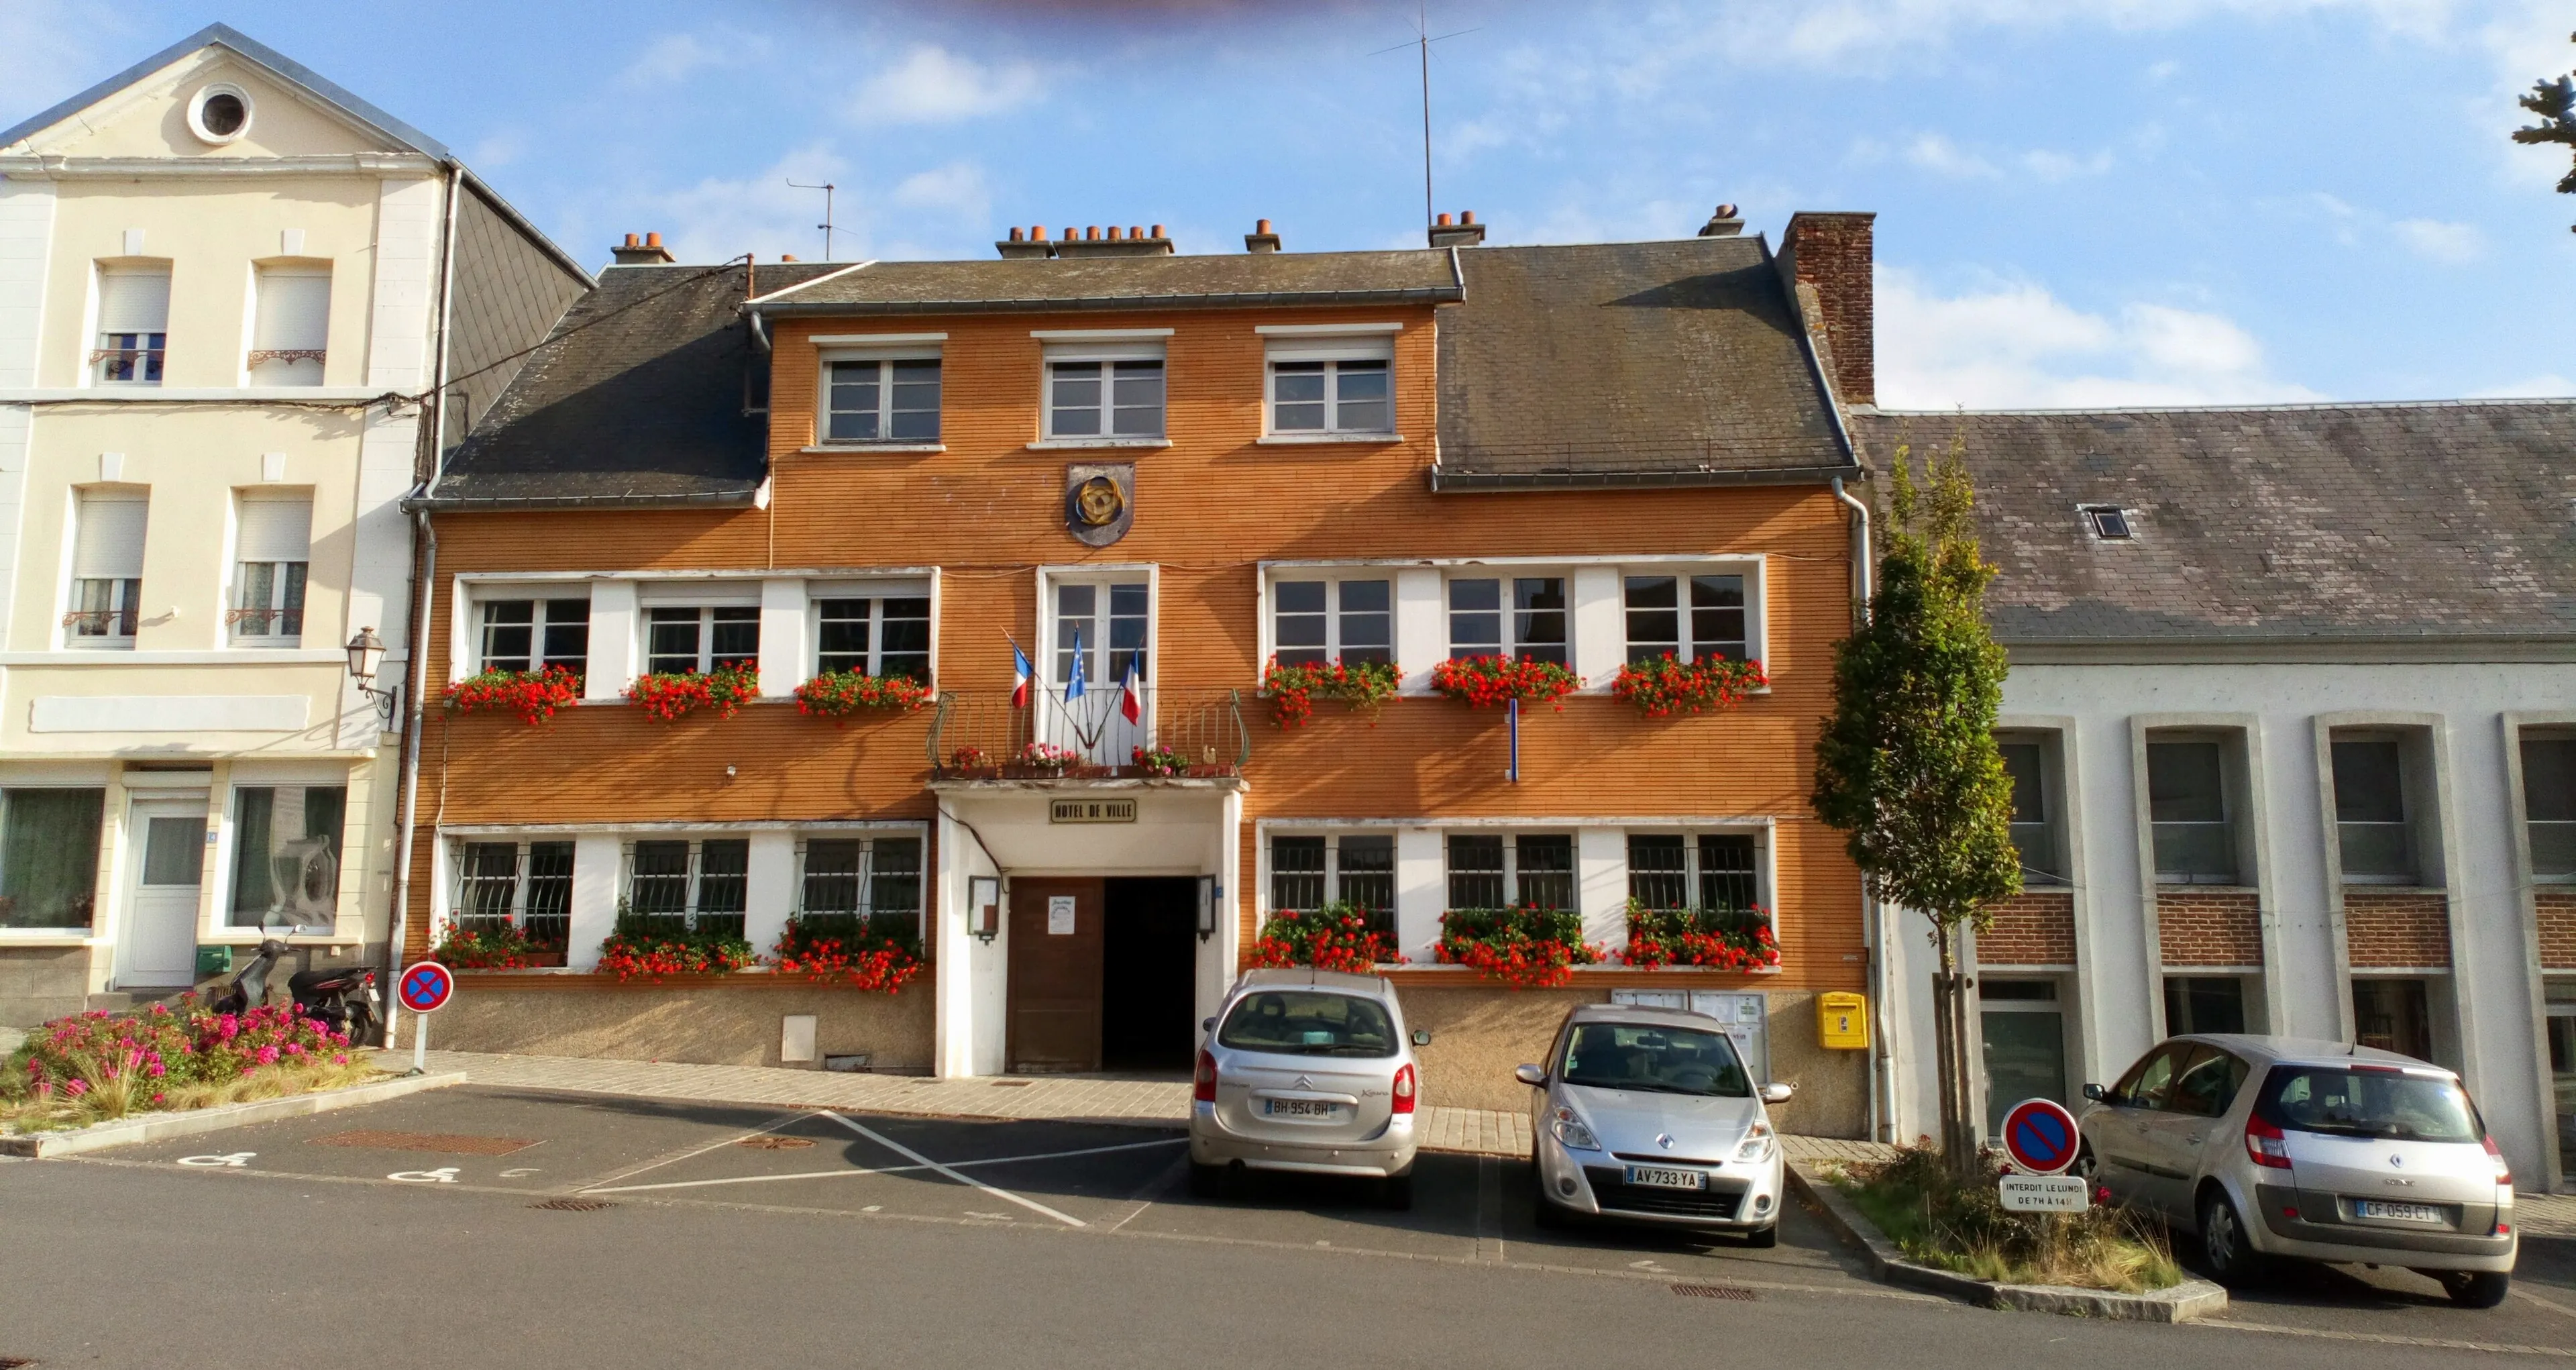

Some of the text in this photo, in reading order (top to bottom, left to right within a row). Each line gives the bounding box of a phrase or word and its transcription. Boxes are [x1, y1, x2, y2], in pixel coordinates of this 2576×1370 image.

[1055, 804, 1132, 818] HOTEL DE VILLE
[1637, 1169, 1696, 1187] AV-733-YA
[2006, 1183, 2042, 1192] INTERDIT
[2057, 1185, 2082, 1193] LUNDI
